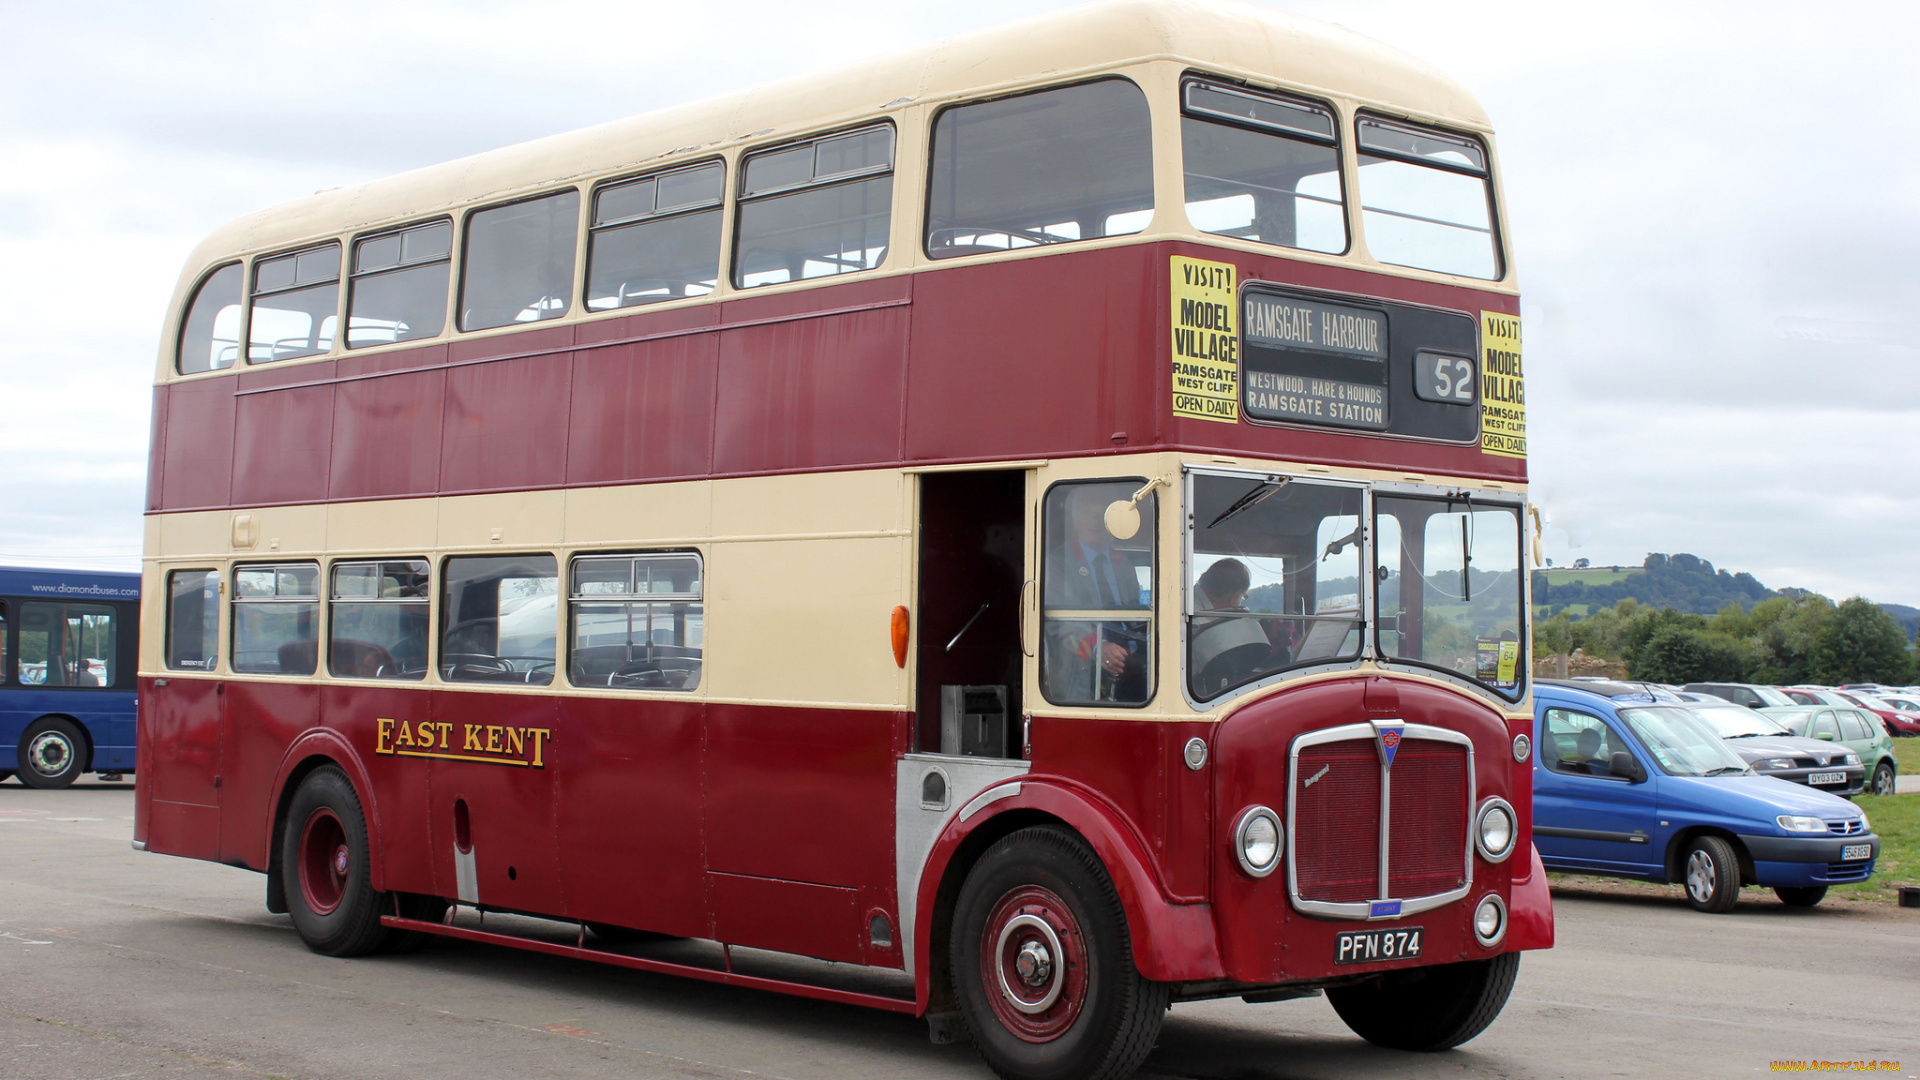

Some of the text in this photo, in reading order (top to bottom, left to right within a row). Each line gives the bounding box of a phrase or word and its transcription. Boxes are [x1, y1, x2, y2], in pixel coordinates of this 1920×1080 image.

[1183, 263, 1231, 294] VISIT!
[1180, 298, 1231, 333] MODEL
[1246, 300, 1378, 353] RAMSGATE HARBOUR
[1174, 328, 1237, 364] VILLAGE
[1173, 362, 1237, 382] RAMSGATE
[1486, 348, 1524, 378] MODEL
[1178, 377, 1234, 394] WEST CLIFF
[1249, 374, 1382, 404] WESTWOOD, HARE & HOUNDS
[1434, 358, 1473, 399] 52
[1176, 395, 1235, 416] OPEN DAILY
[1248, 391, 1383, 424] RAMSGATE STATION
[1485, 418, 1505, 429] WEST
[1483, 434, 1505, 449] OPEN
[32, 583, 139, 597] www.diamondbuses.com
[1504, 650, 1514, 661] 64
[376, 717, 552, 768] EAST KENT
[1339, 931, 1420, 961] PFN 874
